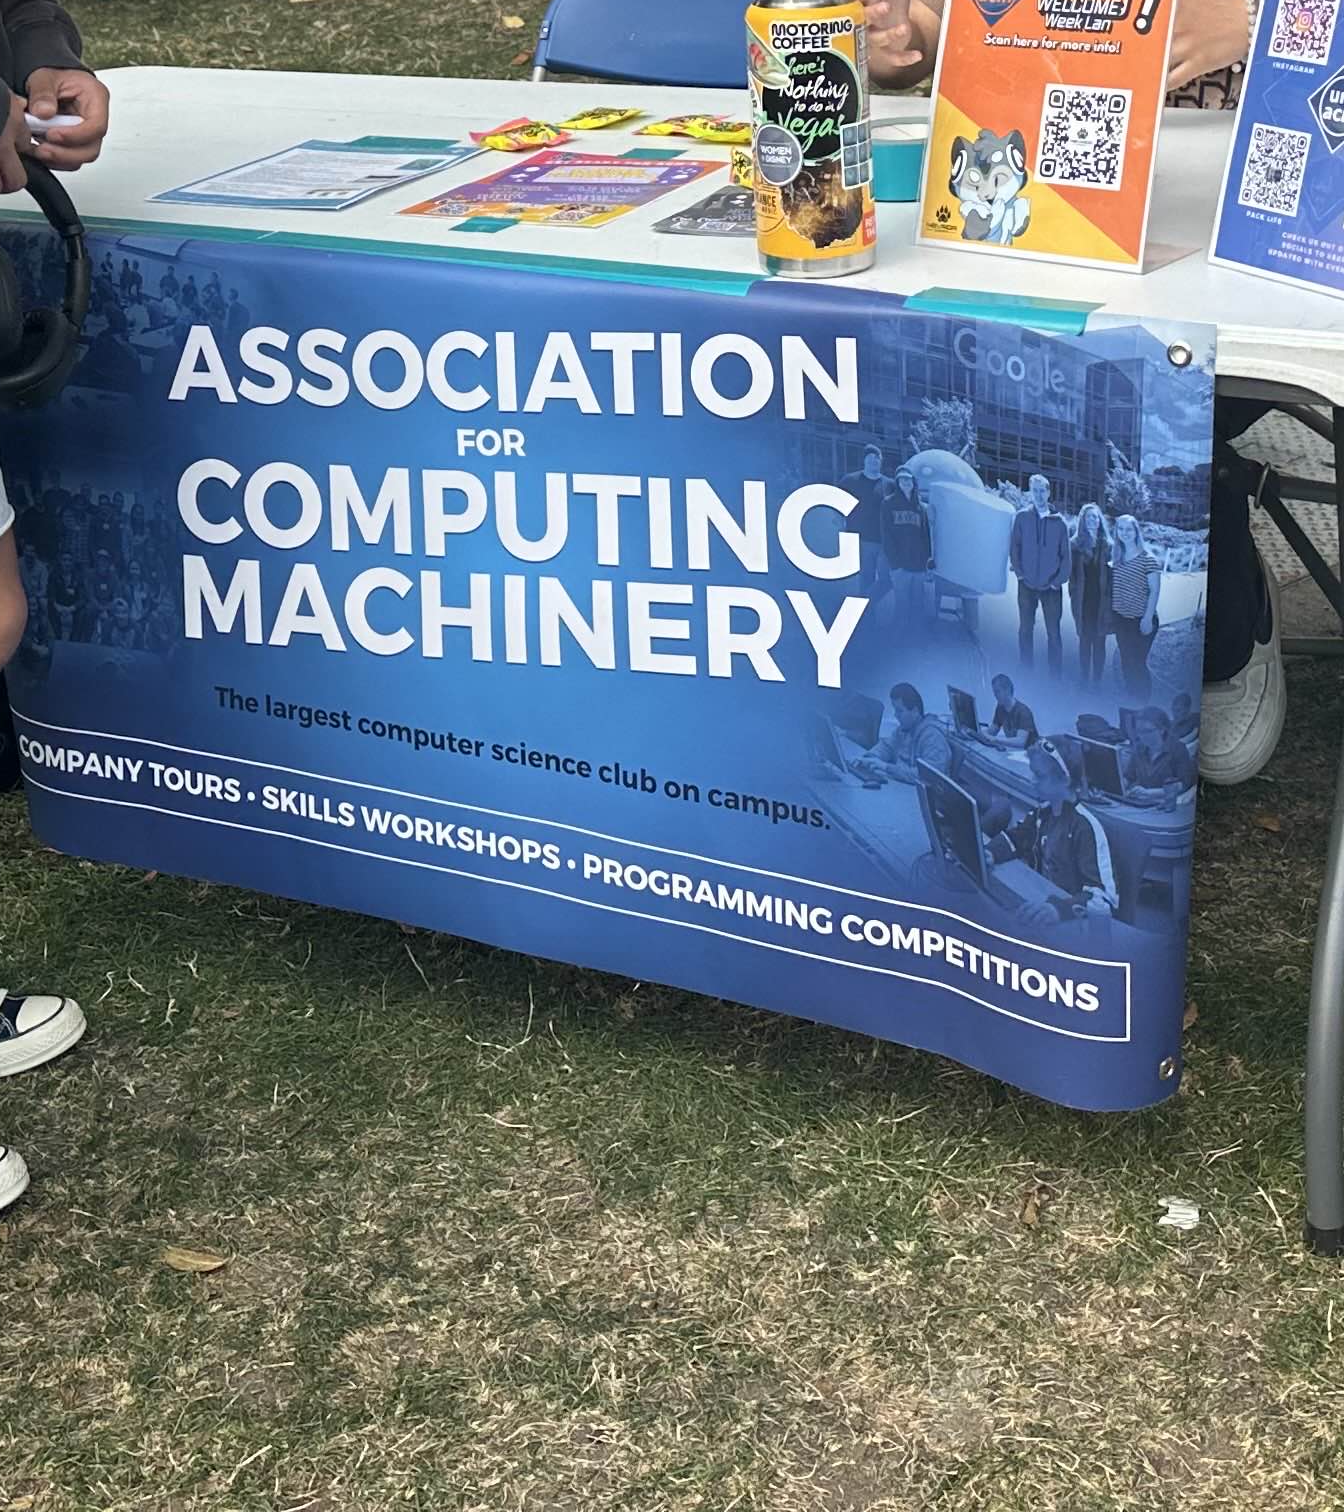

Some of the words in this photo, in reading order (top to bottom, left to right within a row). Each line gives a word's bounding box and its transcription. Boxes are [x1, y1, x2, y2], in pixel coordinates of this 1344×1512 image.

[771, 19, 853, 37] MOTORING
[1045, 14, 1082, 30] Week
[1084, 16, 1112, 32] Lan
[772, 36, 830, 50] COFFEE
[984, 33, 1011, 47] Scan
[1013, 34, 1038, 49] here
[1041, 36, 1059, 50] for
[1060, 40, 1091, 53] more
[788, 56, 826, 76] here's
[1272, 61, 1315, 75] INSTAGRAM
[779, 75, 849, 111] Nothing
[778, 107, 845, 153] Vegas
[760, 145, 792, 155] WOMEN
[1246, 210, 1265, 221] PACK
[168, 324, 860, 423] ASSOCIATION
[457, 428, 526, 457] FOR
[177, 458, 861, 580] COMPUTING
[182, 554, 870, 688] MACHINERY
[214, 685, 259, 713] The
[264, 694, 353, 734] largest
[358, 714, 485, 759] computer
[490, 738, 592, 777] science
[598, 761, 658, 794] club
[663, 779, 702, 803] on
[707, 787, 832, 833] campus.
[19, 733, 144, 784] COMPANY
[148, 761, 241, 804] TOURS
[261, 785, 356, 827] SKILLS
[360, 804, 562, 870] WORKSHOPS
[582, 852, 834, 936] PROGRAMMING
[840, 913, 1100, 1013] COMPETITIONS
